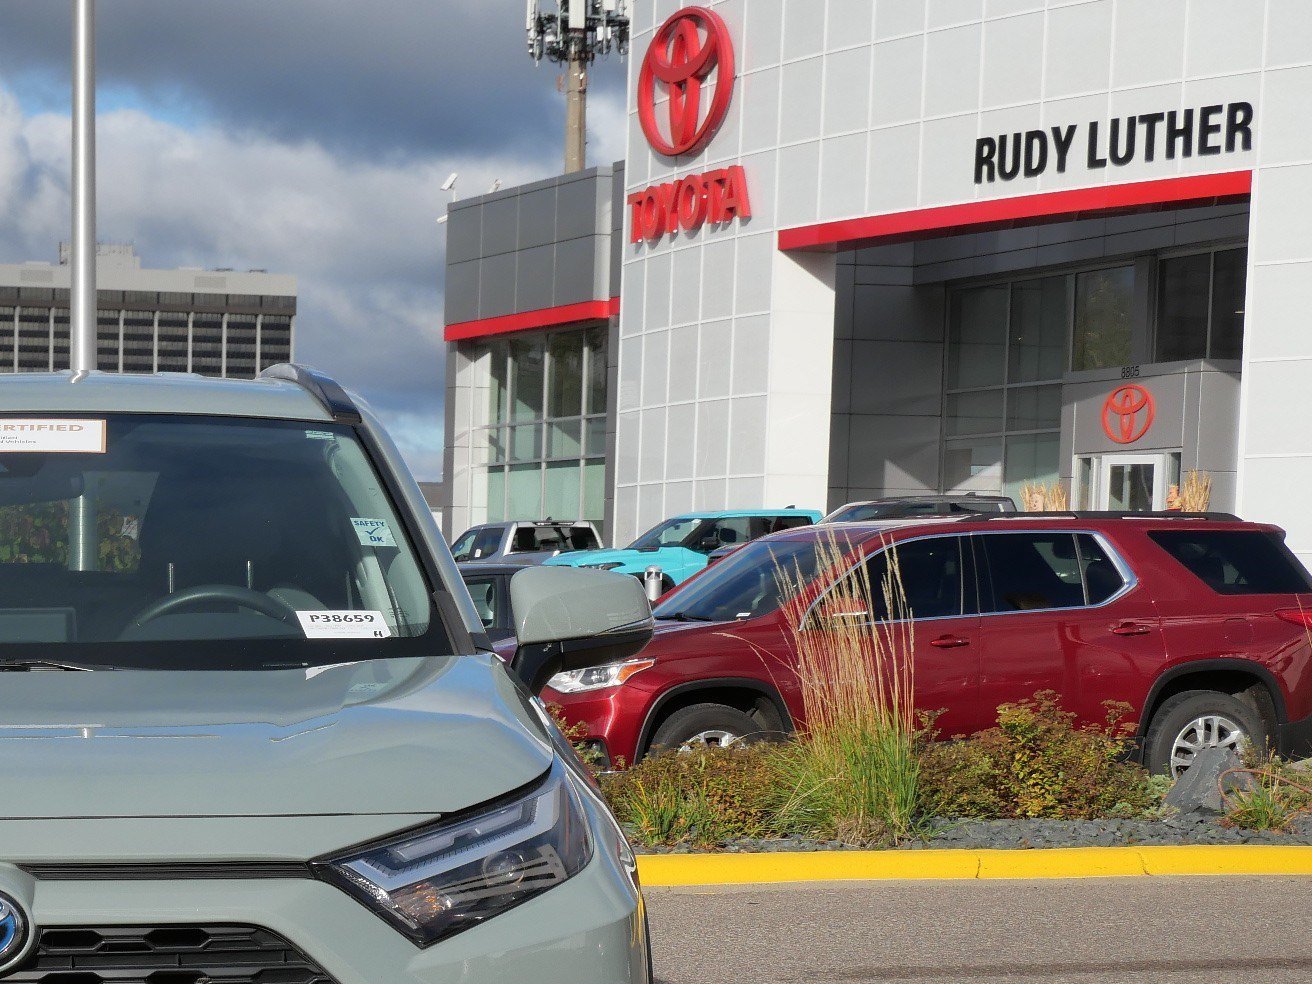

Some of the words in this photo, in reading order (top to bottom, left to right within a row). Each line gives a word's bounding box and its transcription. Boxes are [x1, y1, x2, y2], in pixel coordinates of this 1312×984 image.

[974, 123, 1078, 185] RUDY
[1086, 101, 1254, 171] LUTHER
[627, 165, 752, 244] TOYOTA
[369, 535, 385, 543] OK
[309, 614, 375, 623] P38659
